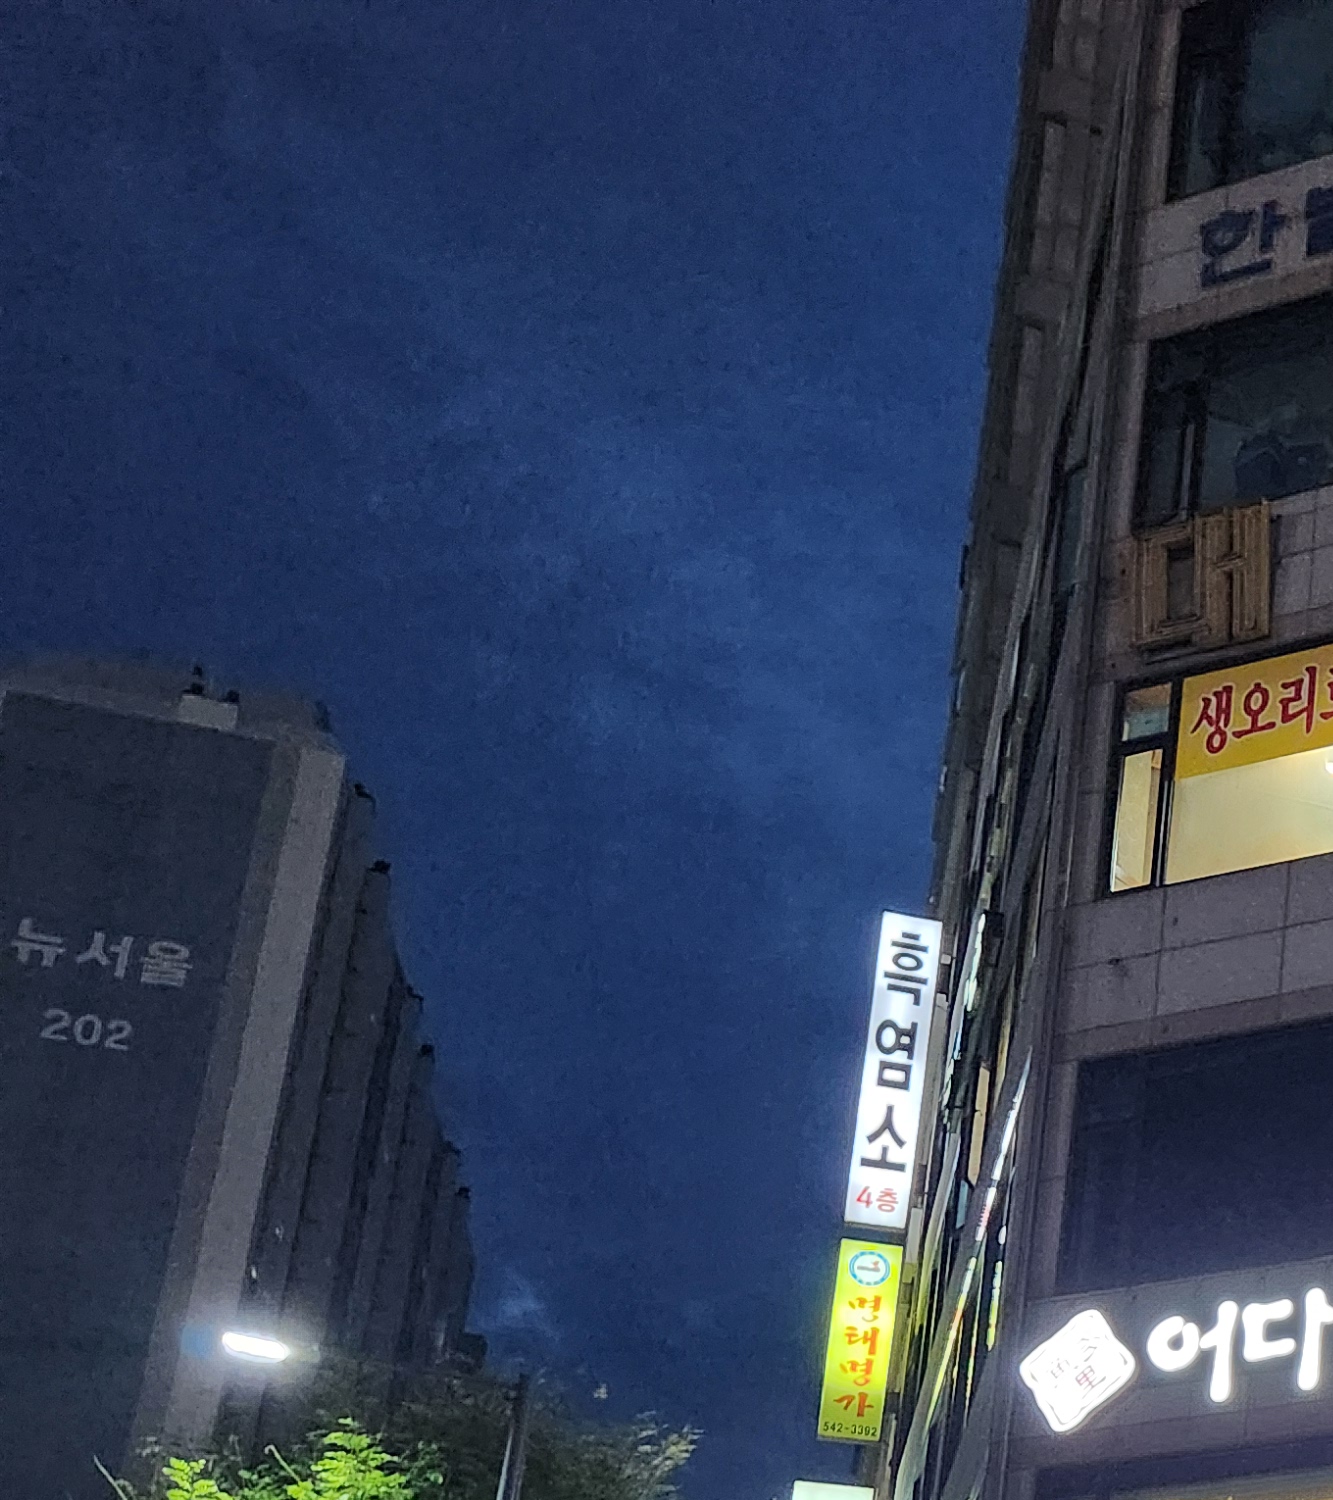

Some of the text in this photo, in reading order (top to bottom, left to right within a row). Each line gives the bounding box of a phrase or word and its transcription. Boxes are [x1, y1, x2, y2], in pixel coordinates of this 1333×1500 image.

[11, 916, 193, 987] 뉴서울
[41, 1008, 132, 1051] 202
[861, 931, 929, 1172] 흑염소
[856, 1185, 899, 1214] 4층
